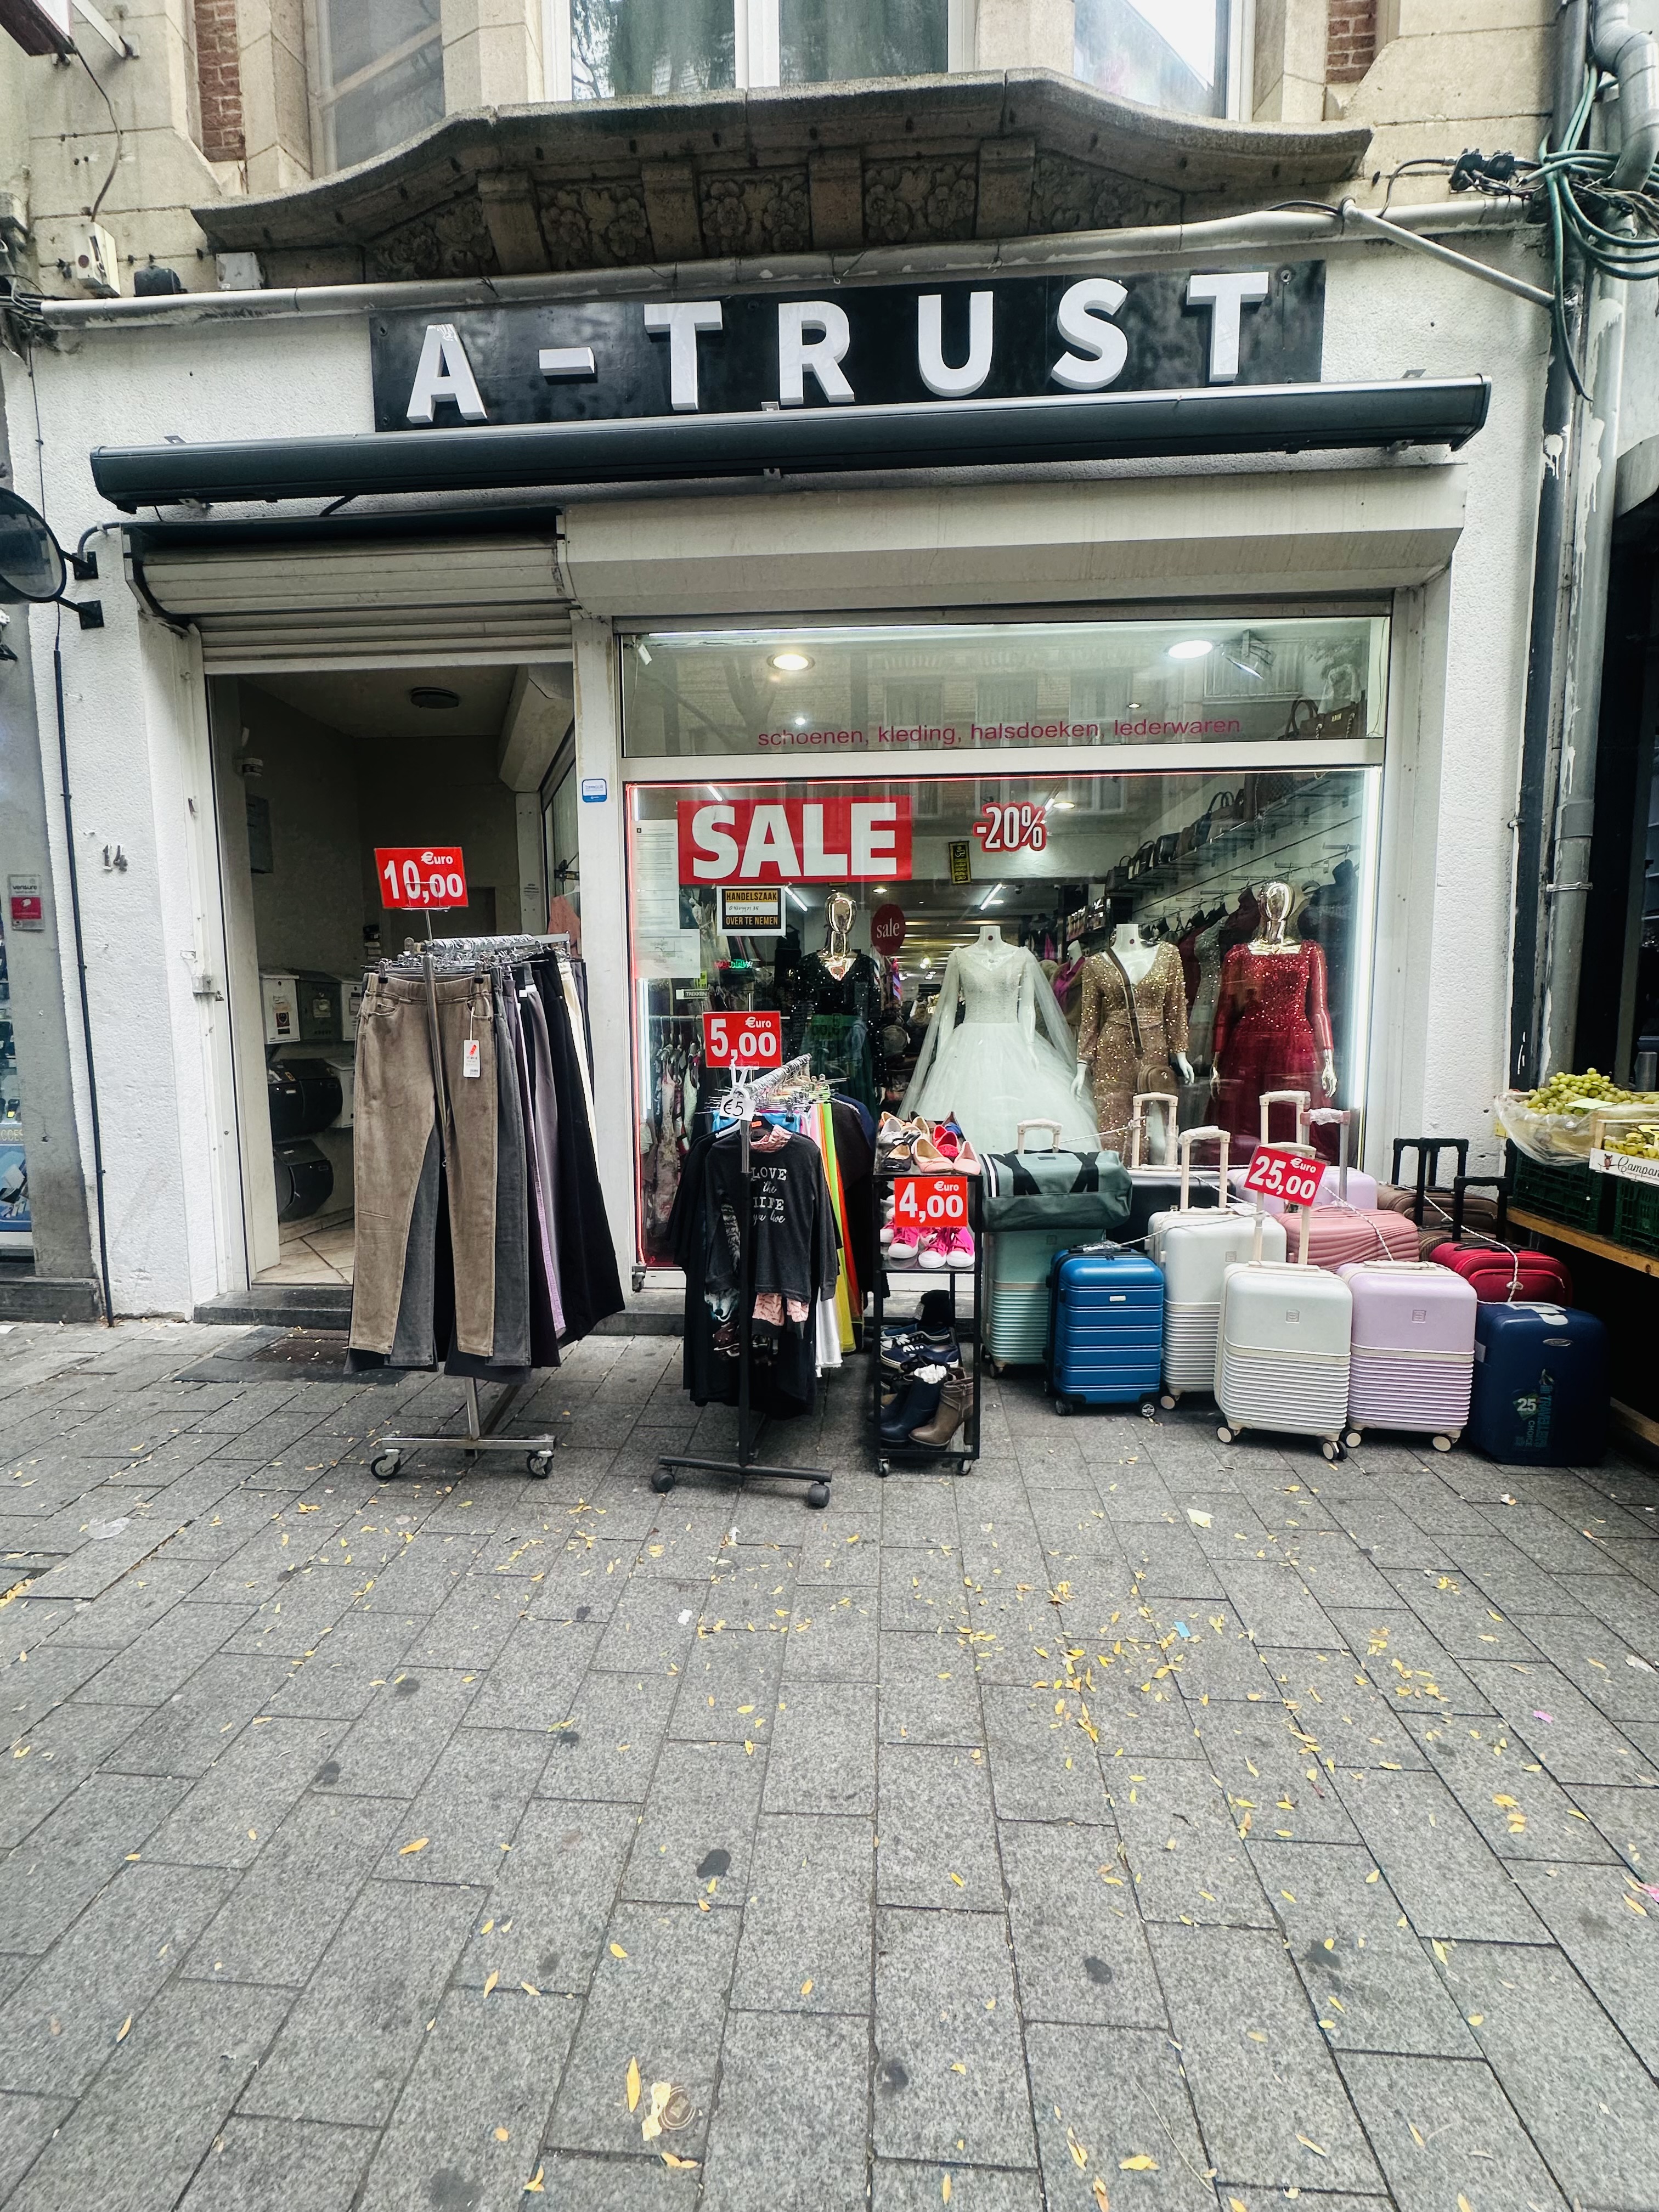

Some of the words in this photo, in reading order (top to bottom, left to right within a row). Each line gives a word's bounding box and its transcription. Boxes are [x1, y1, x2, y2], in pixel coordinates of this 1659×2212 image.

[758, 729, 869, 746] schoenen,
[878, 725, 962, 745] kleding,
[971, 721, 1105, 740] halsdoeken,
[1115, 719, 1240, 736] lederwaren
[977, 805, 1043, 849] -20%
[691, 803, 897, 879] SALE
[103, 844, 127, 871] 14
[421, 851, 454, 865] €uro
[384, 860, 463, 904] 10,00
[726, 892, 777, 901] HANDELSZAAK
[726, 917, 743, 926] OVER
[745, 916, 753, 925] TE
[755, 916, 778, 926] NEMEN
[876, 917, 900, 939] sale
[745, 1017, 772, 1028] €uro
[710, 1018, 777, 1061] 5,00
[724, 1099, 743, 1116] €5
[751, 1167, 787, 1181] LOVE
[1290, 1158, 1317, 1173] €uro
[1249, 1155, 1316, 1199] 25,00
[763, 1181, 777, 1193] the
[934, 1181, 960, 1191] €uro
[899, 1182, 963, 1223] 4,00
[1517, 1398, 1536, 1412] 25
